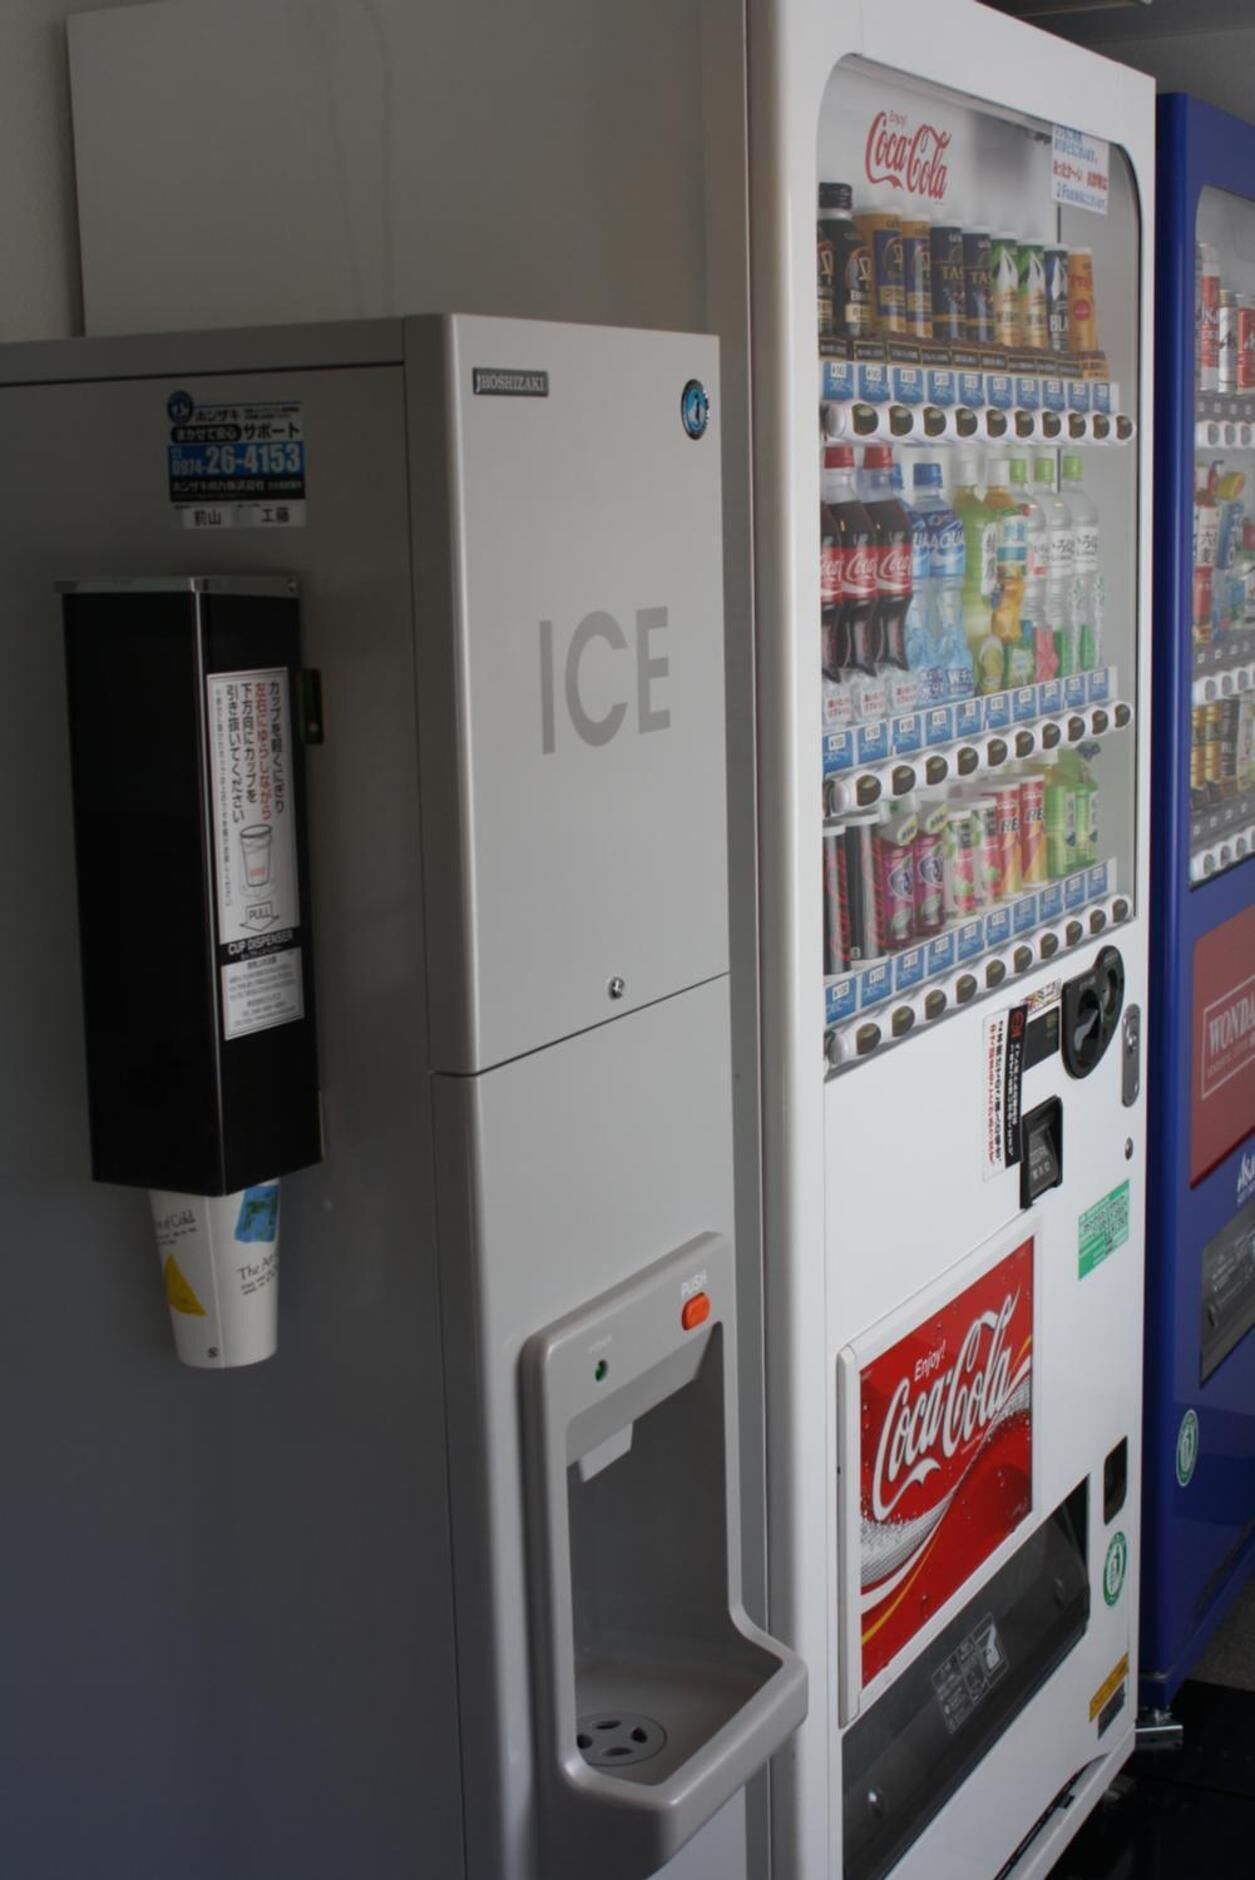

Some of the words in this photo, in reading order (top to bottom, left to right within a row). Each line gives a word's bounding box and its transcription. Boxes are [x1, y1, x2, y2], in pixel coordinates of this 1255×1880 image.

[864, 110, 952, 201] Coca-Cola
[244, 421, 300, 440] サポート
[479, 373, 545, 392] HOSHIZAKI
[538, 605, 672, 755] ICE
[225, 683, 246, 824] 引き抜いてください
[240, 681, 258, 804] 下方向にカップを
[254, 681, 273, 821] 左右にゆらしながら
[227, 940, 246, 957] CUP
[247, 929, 294, 951] DISPENSER
[871, 1285, 1021, 1523] Coca-Cola
